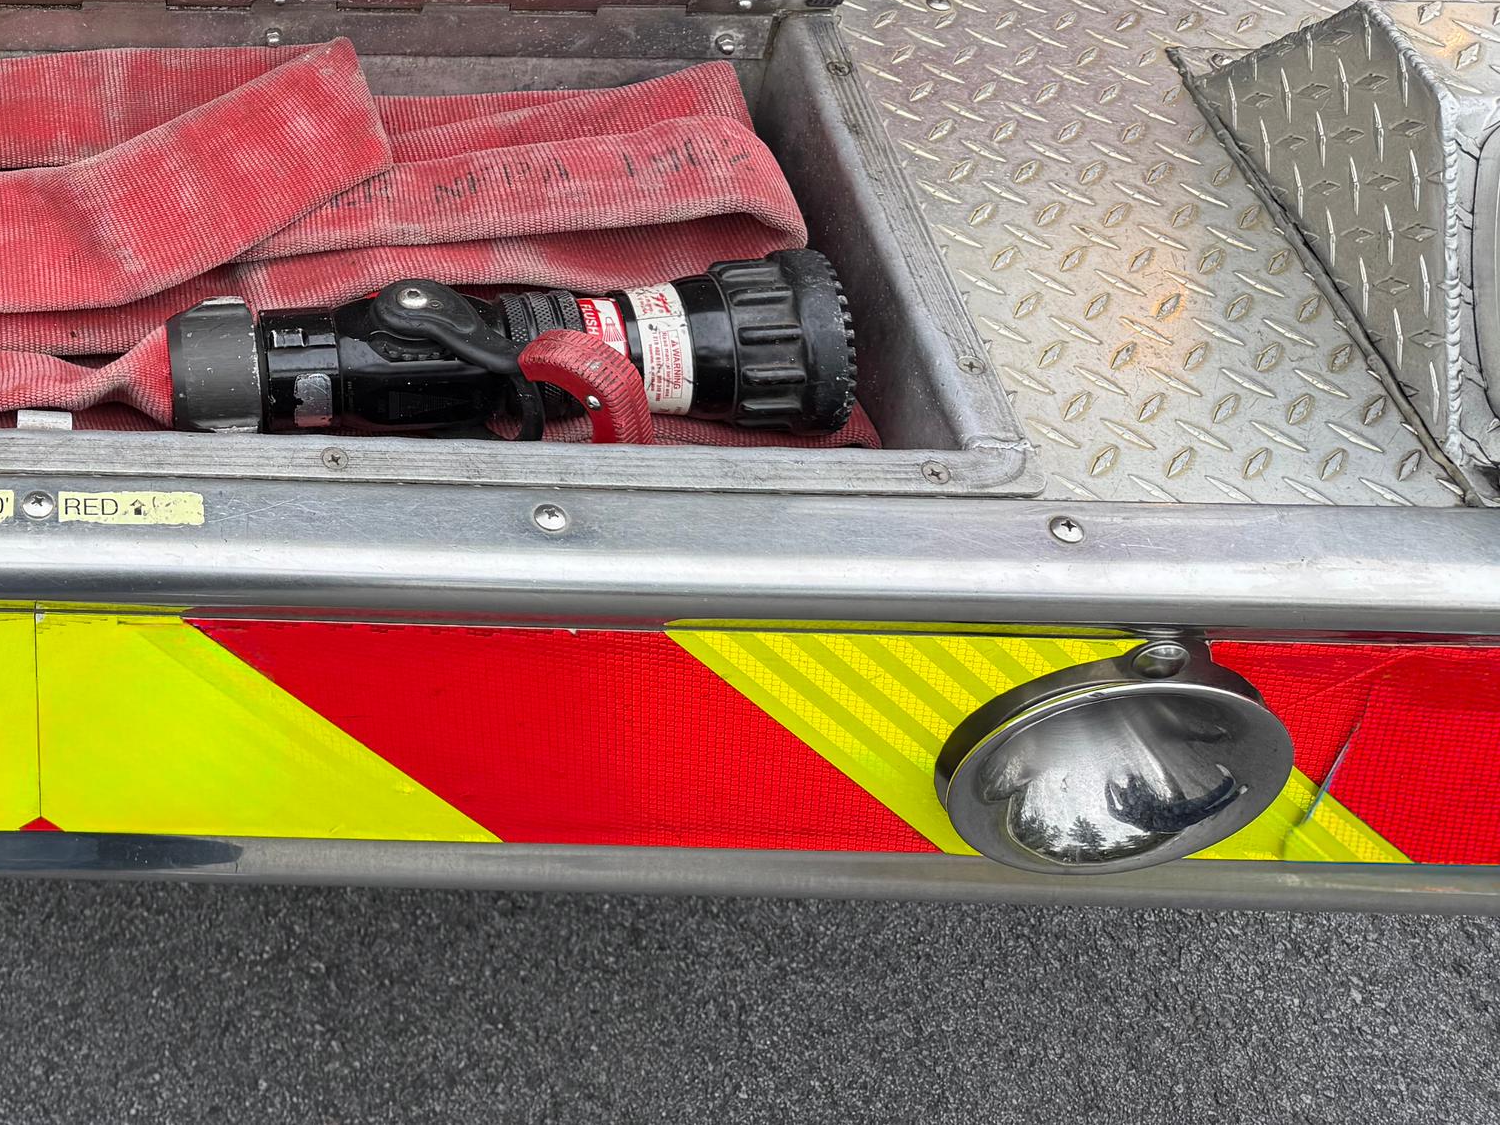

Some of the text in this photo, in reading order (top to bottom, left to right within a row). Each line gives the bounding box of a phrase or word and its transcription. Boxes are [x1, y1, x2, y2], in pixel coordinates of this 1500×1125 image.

[580, 304, 600, 336] FLUSH
[672, 347, 682, 390] WARNING
[64, 497, 118, 516] RED
